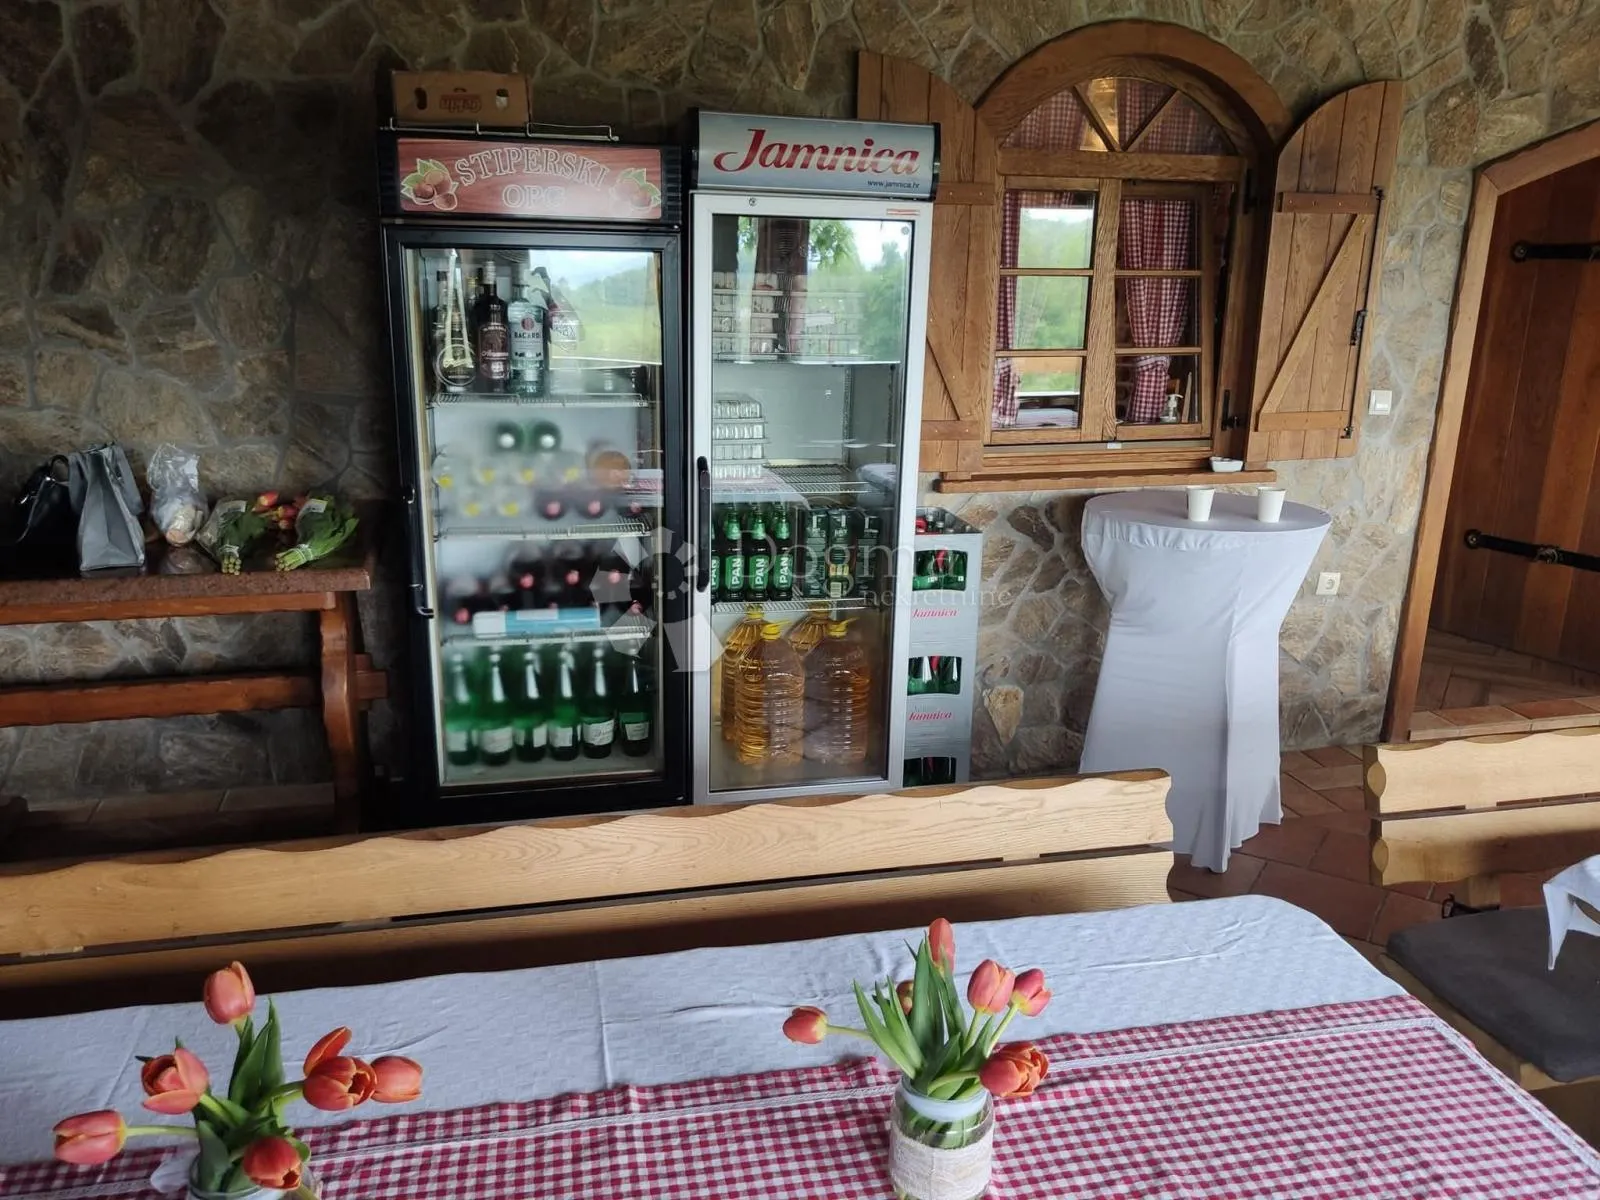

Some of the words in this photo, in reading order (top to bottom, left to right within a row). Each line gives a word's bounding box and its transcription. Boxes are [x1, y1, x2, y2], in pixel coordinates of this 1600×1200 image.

[713, 128, 920, 175] Jamnica
[455, 146, 609, 191] STIPERSKI
[867, 179, 920, 189] www.jamnica.hr
[514, 331, 541, 339] BACARD
[731, 558, 742, 585] PAN
[755, 558, 765, 585] PAN
[779, 557, 789, 584] PAN
